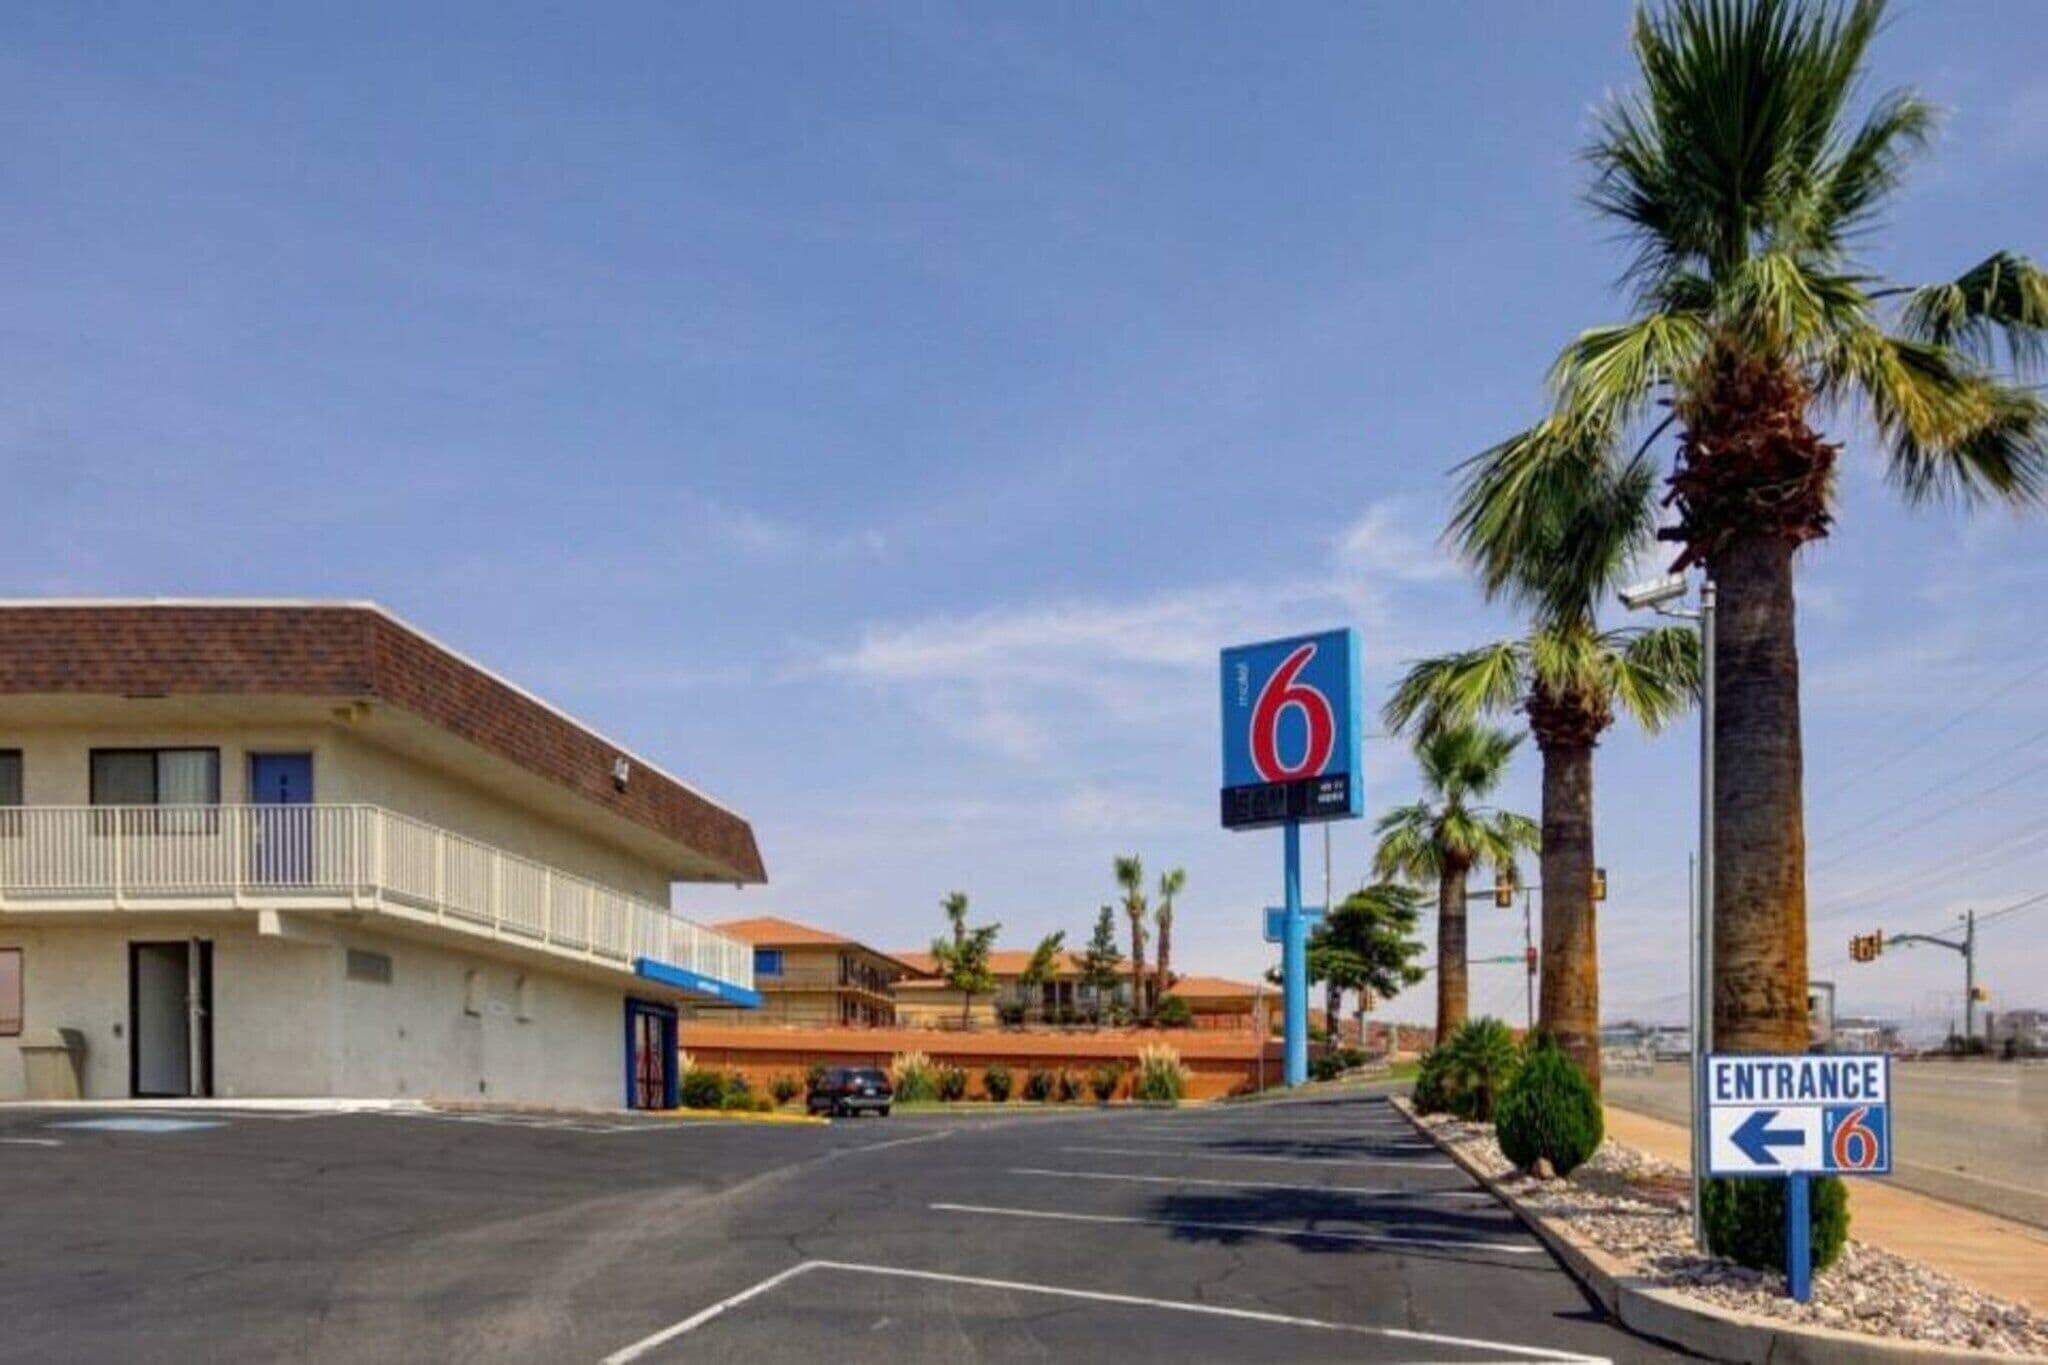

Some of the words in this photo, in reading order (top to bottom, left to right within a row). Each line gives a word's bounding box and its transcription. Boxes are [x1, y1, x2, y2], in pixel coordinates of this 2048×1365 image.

[1250, 643, 1335, 782] 6
[1716, 1061, 1879, 1100] ENTRANCE
[1832, 1103, 1878, 1170] 6
